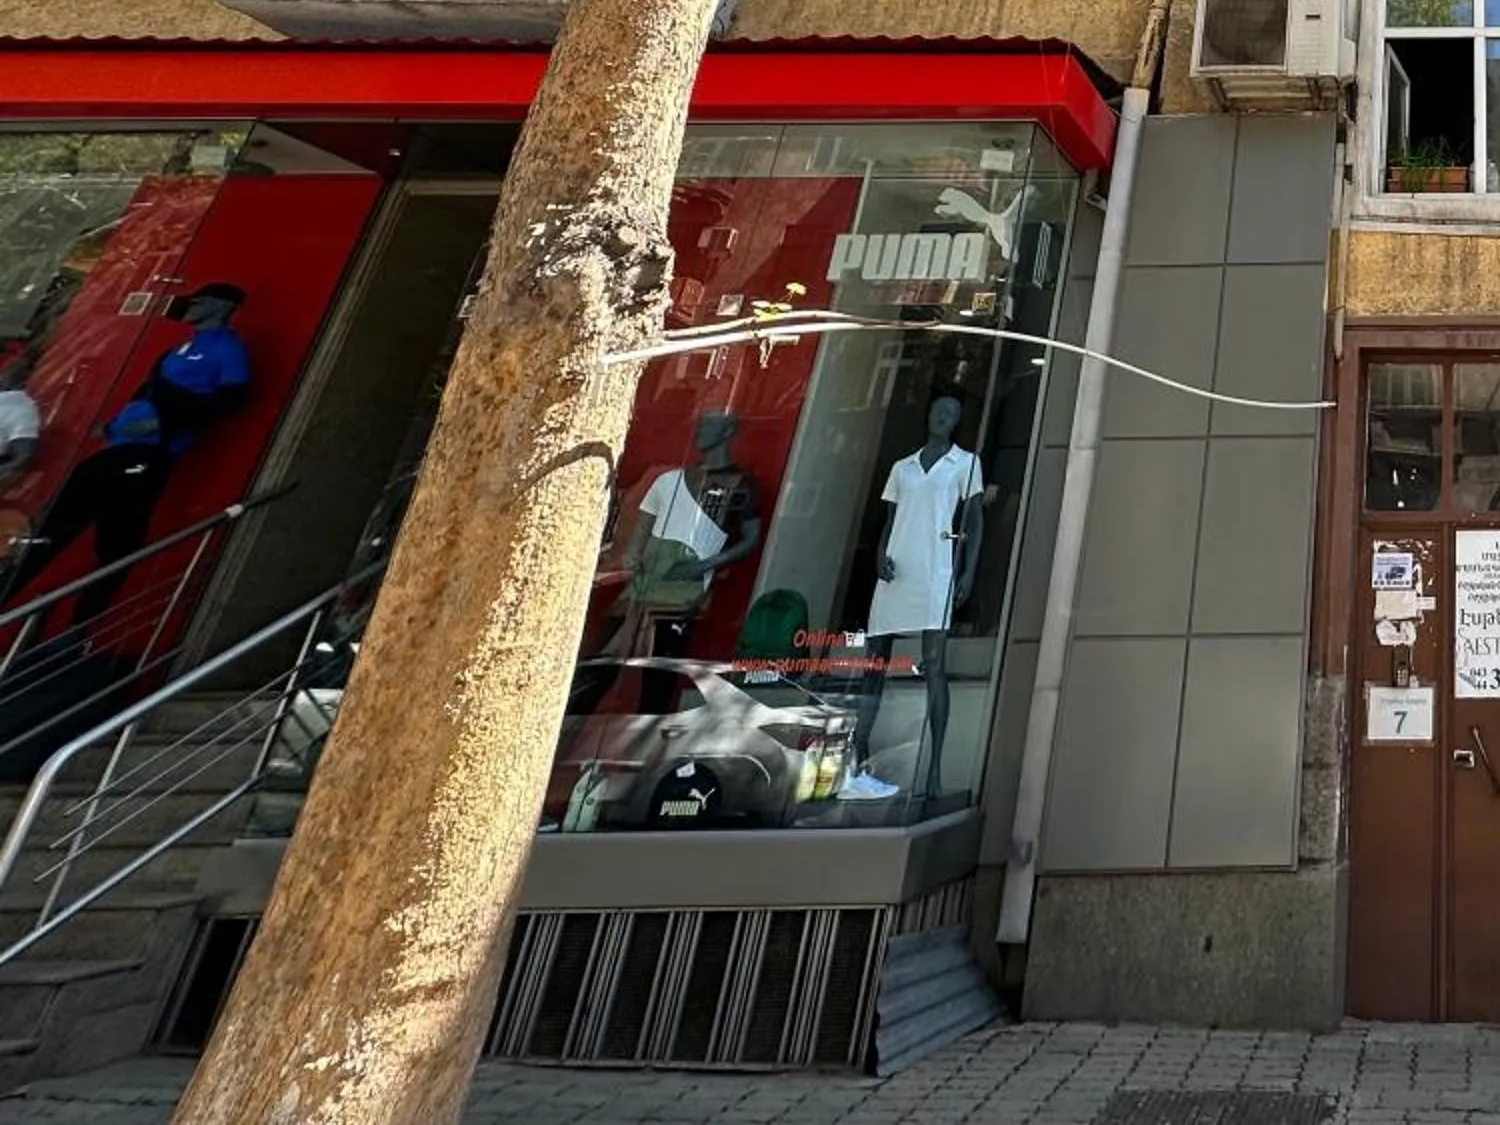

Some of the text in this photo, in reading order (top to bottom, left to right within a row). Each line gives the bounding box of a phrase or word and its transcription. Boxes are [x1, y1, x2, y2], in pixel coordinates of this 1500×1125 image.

[827, 234, 985, 283] PUMA
[1394, 711, 1408, 734] 7
[659, 800, 701, 816] PUMA
